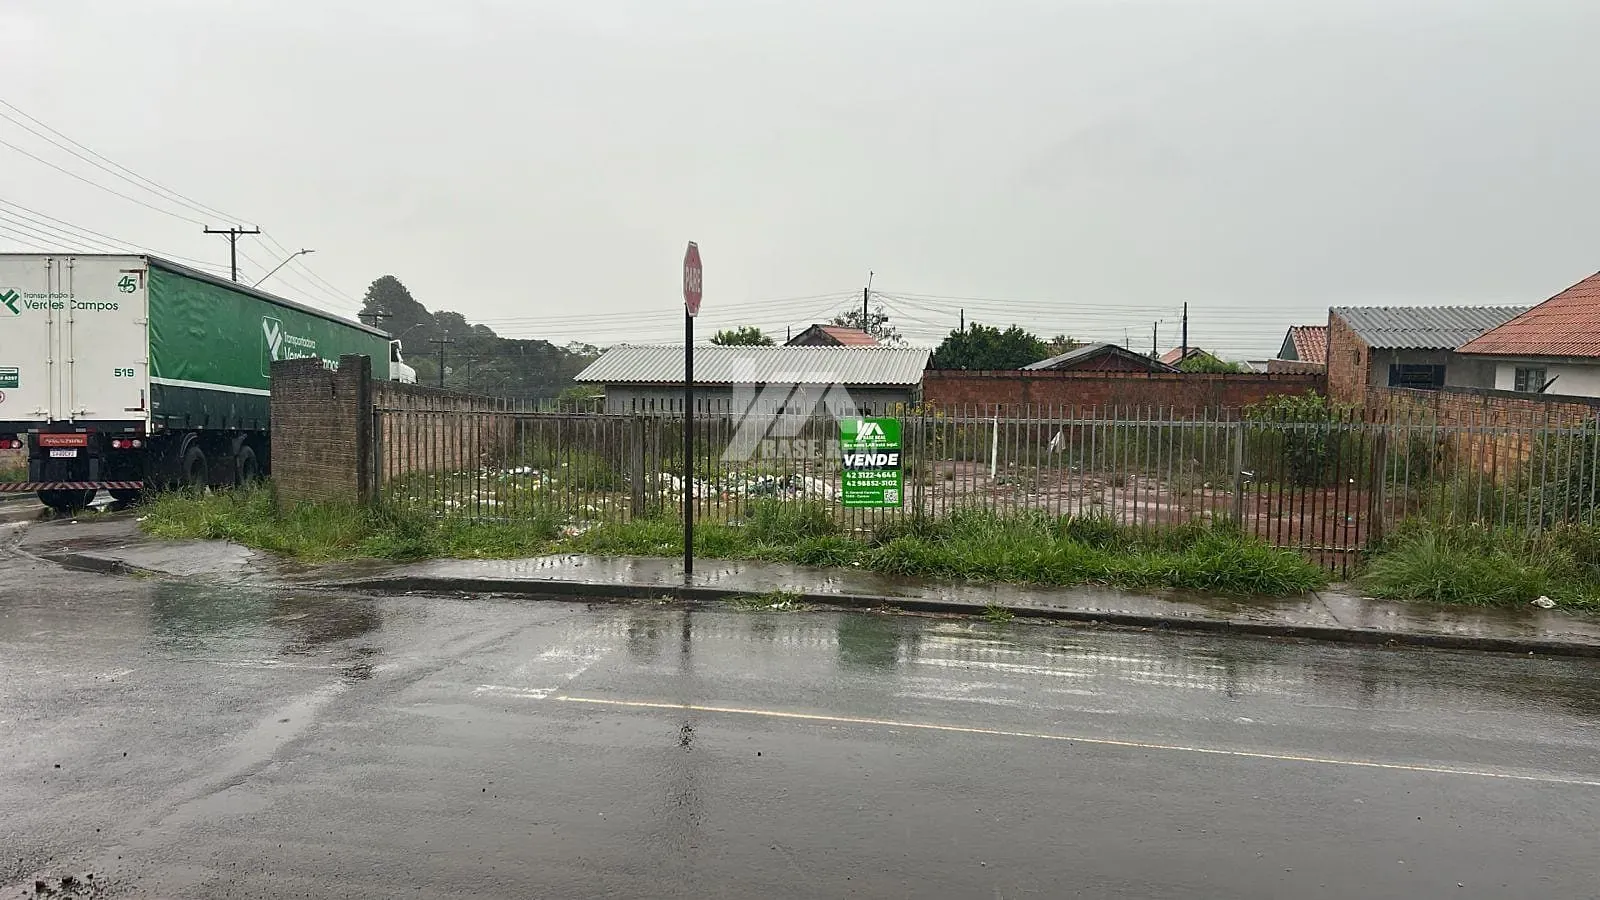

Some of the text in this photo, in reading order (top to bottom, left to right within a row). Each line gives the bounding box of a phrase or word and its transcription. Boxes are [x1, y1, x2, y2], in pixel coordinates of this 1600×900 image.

[685, 266, 701, 293] PARE
[23, 299, 119, 312] Verdes Campos
[114, 368, 134, 377] 519
[843, 453, 899, 466] VENDE
[846, 471, 897, 479] 42 3122-4646
